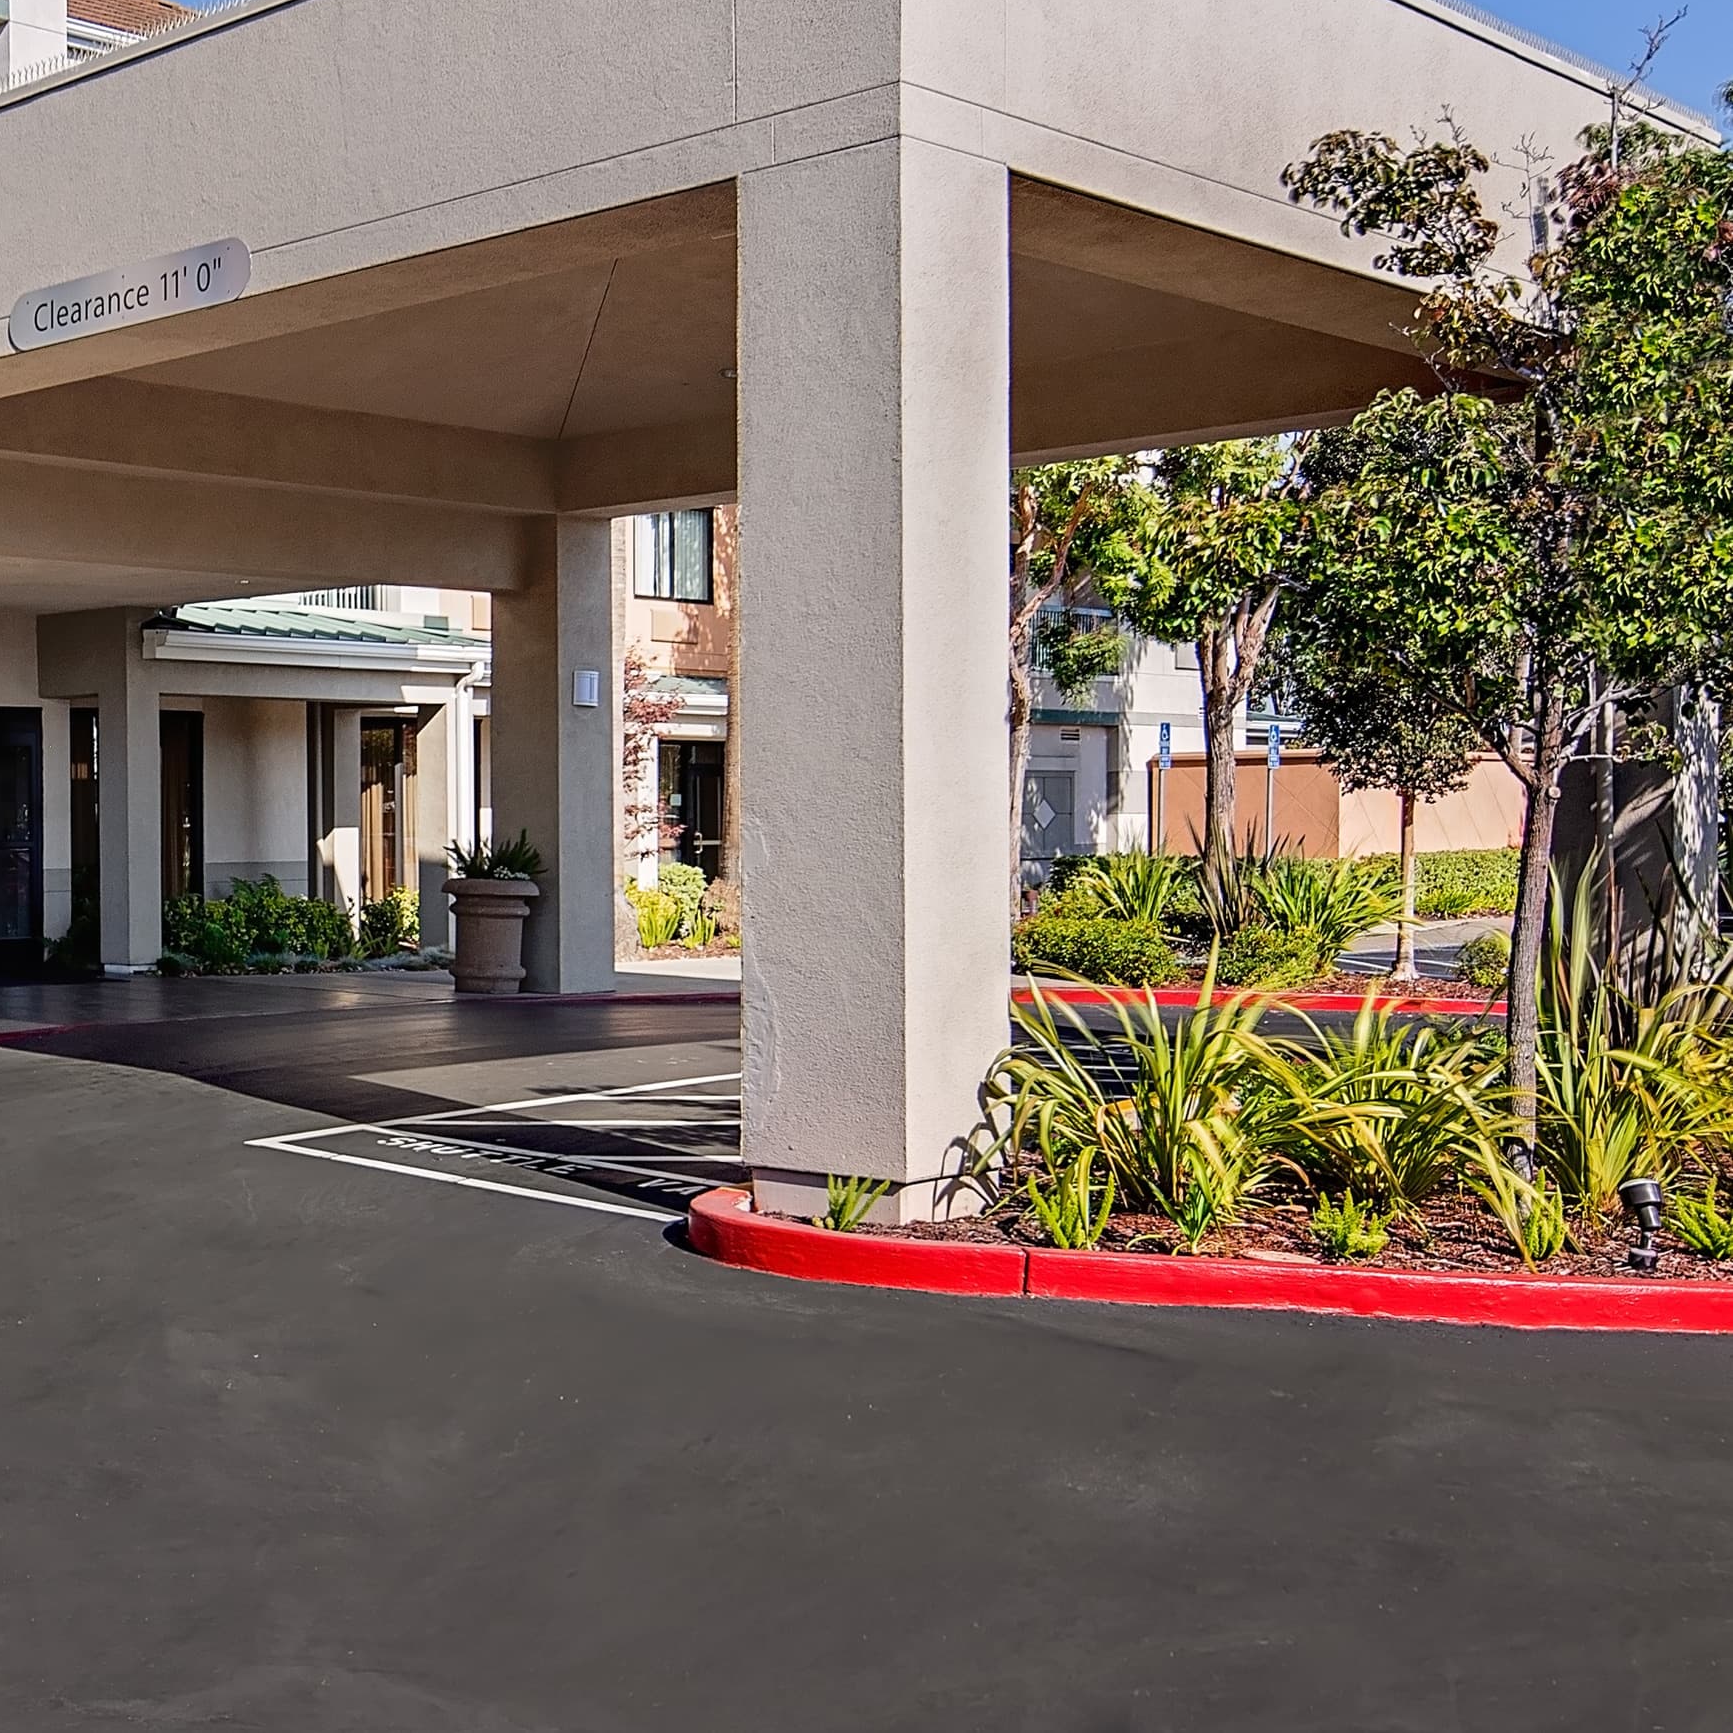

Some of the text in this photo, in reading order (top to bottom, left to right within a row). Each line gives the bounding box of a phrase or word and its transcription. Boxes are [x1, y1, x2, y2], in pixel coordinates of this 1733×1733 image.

[34, 257, 222, 332] Clearance 11' 0"
[377, 1137, 709, 1196] SHUTTLE VA
